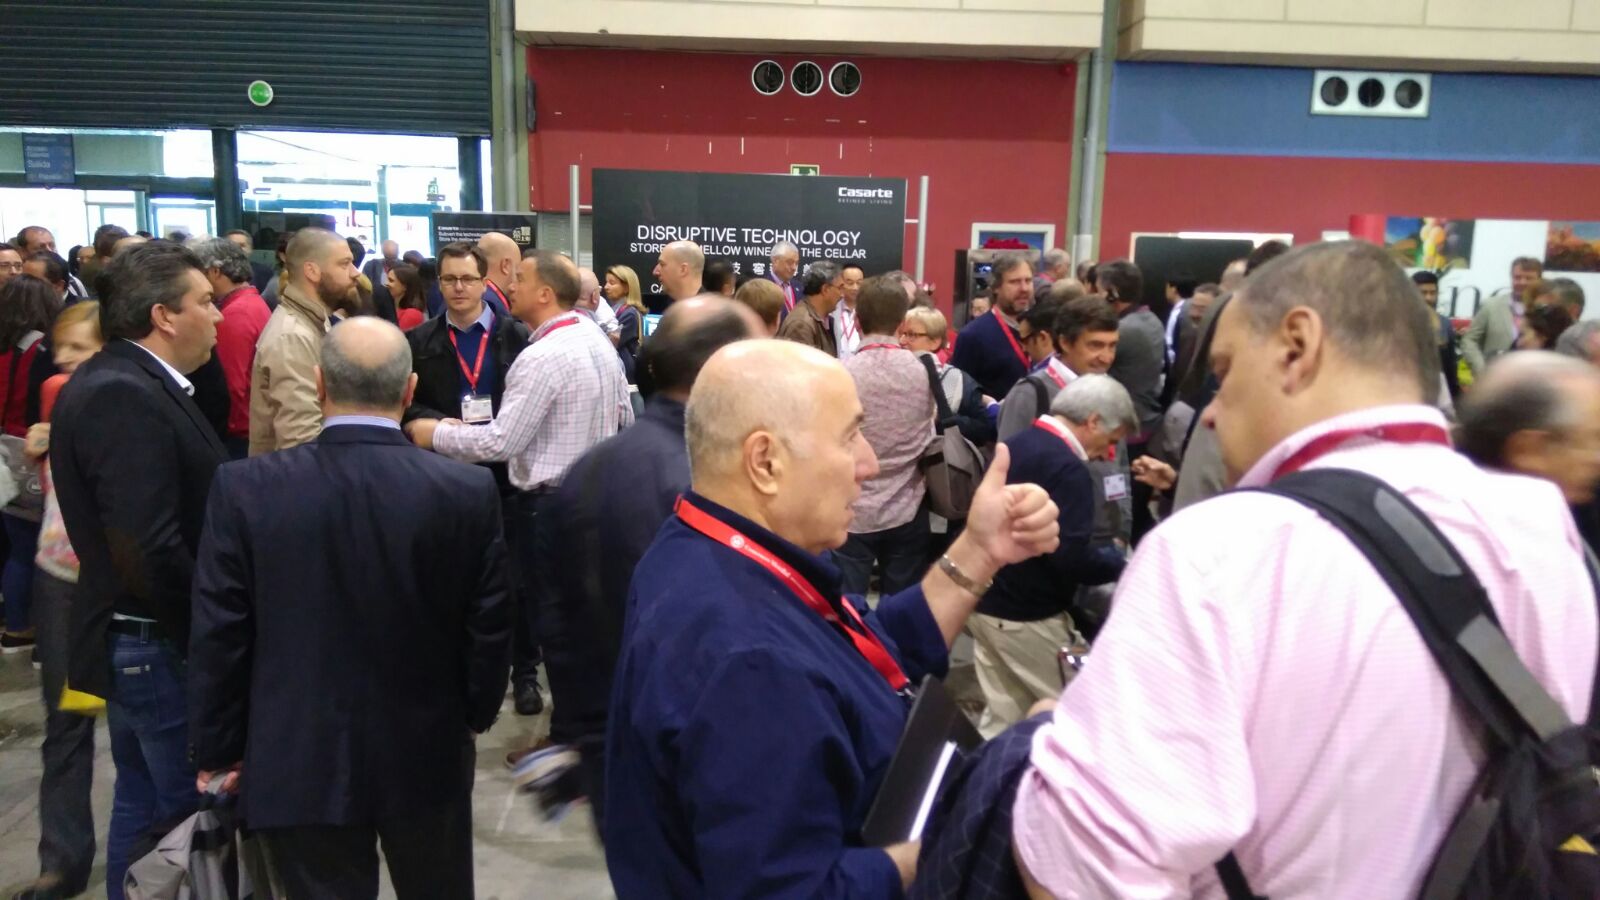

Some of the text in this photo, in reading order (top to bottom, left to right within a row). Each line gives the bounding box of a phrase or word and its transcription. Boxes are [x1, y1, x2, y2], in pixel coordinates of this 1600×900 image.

[838, 186, 893, 198] Casarte
[637, 224, 862, 246] DISRUPTIVE TECHNOLOGY
[699, 245, 741, 256] ELLOW
[801, 247, 822, 258] THE
[824, 248, 867, 259] CELLAR
